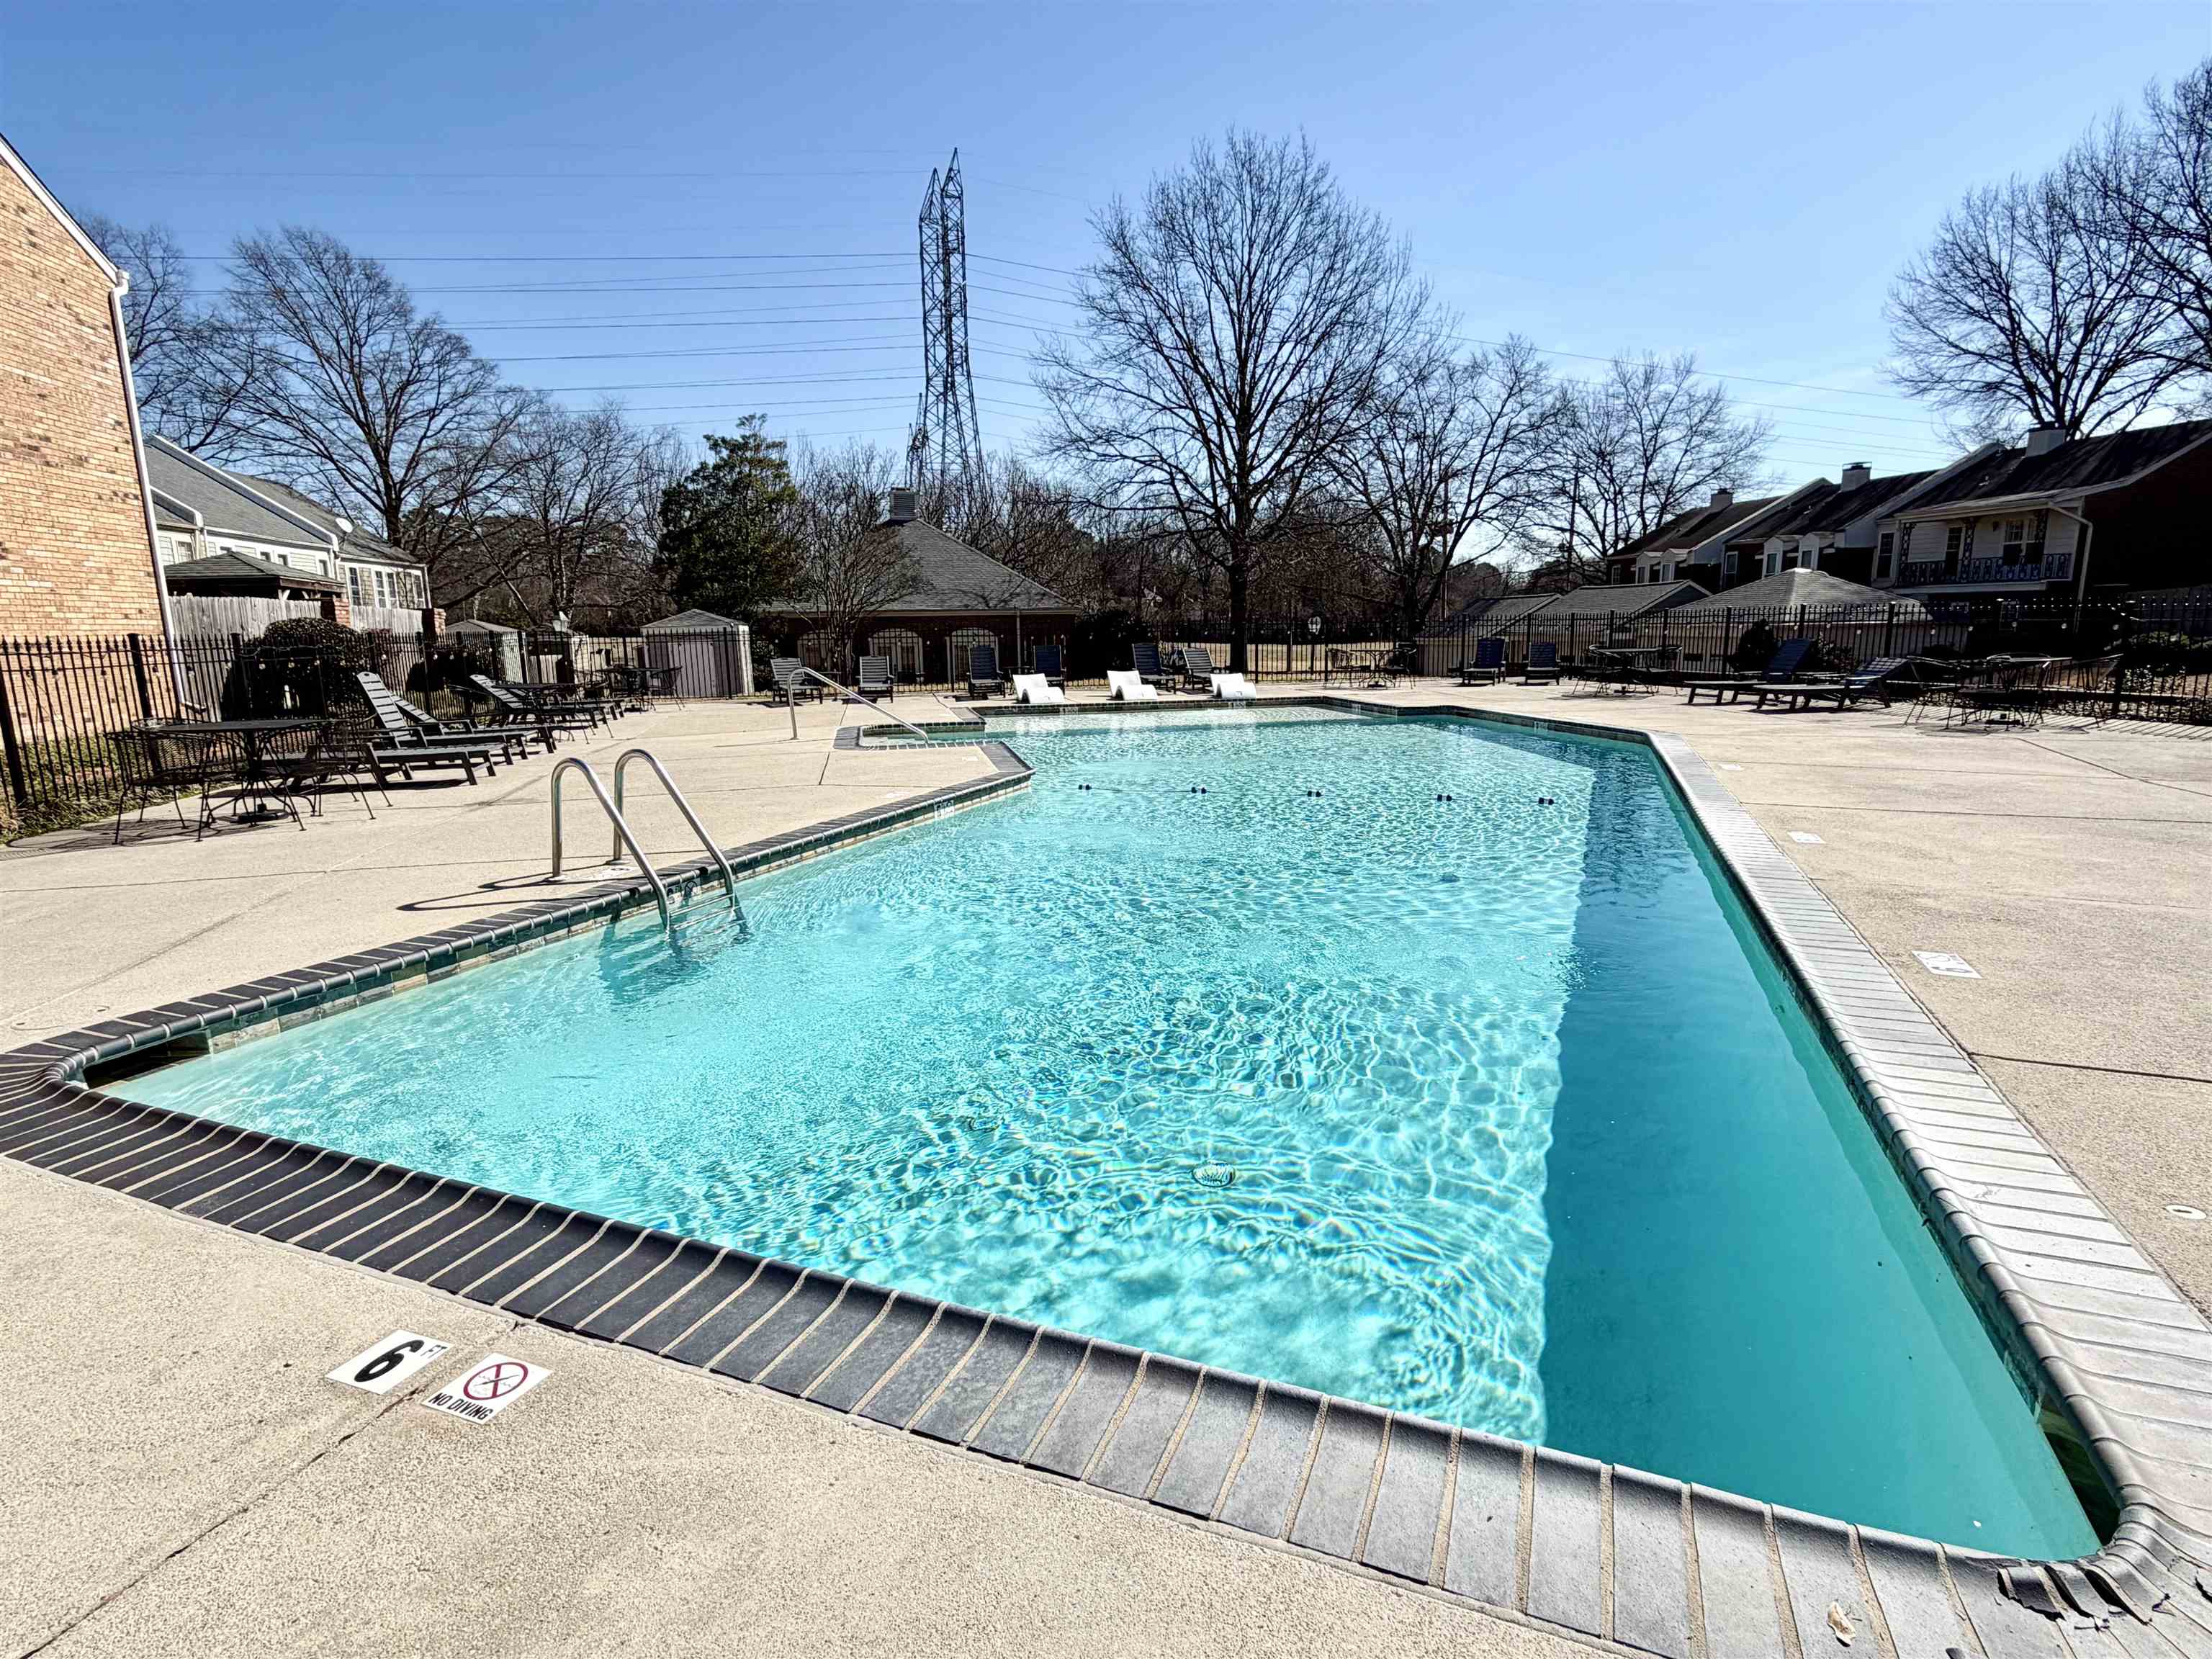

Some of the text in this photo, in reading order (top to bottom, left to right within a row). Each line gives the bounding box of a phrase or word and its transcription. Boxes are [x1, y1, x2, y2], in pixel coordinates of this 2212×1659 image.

[354, 1339, 425, 1382] 6
[429, 1392, 493, 1420] NO DIVING
